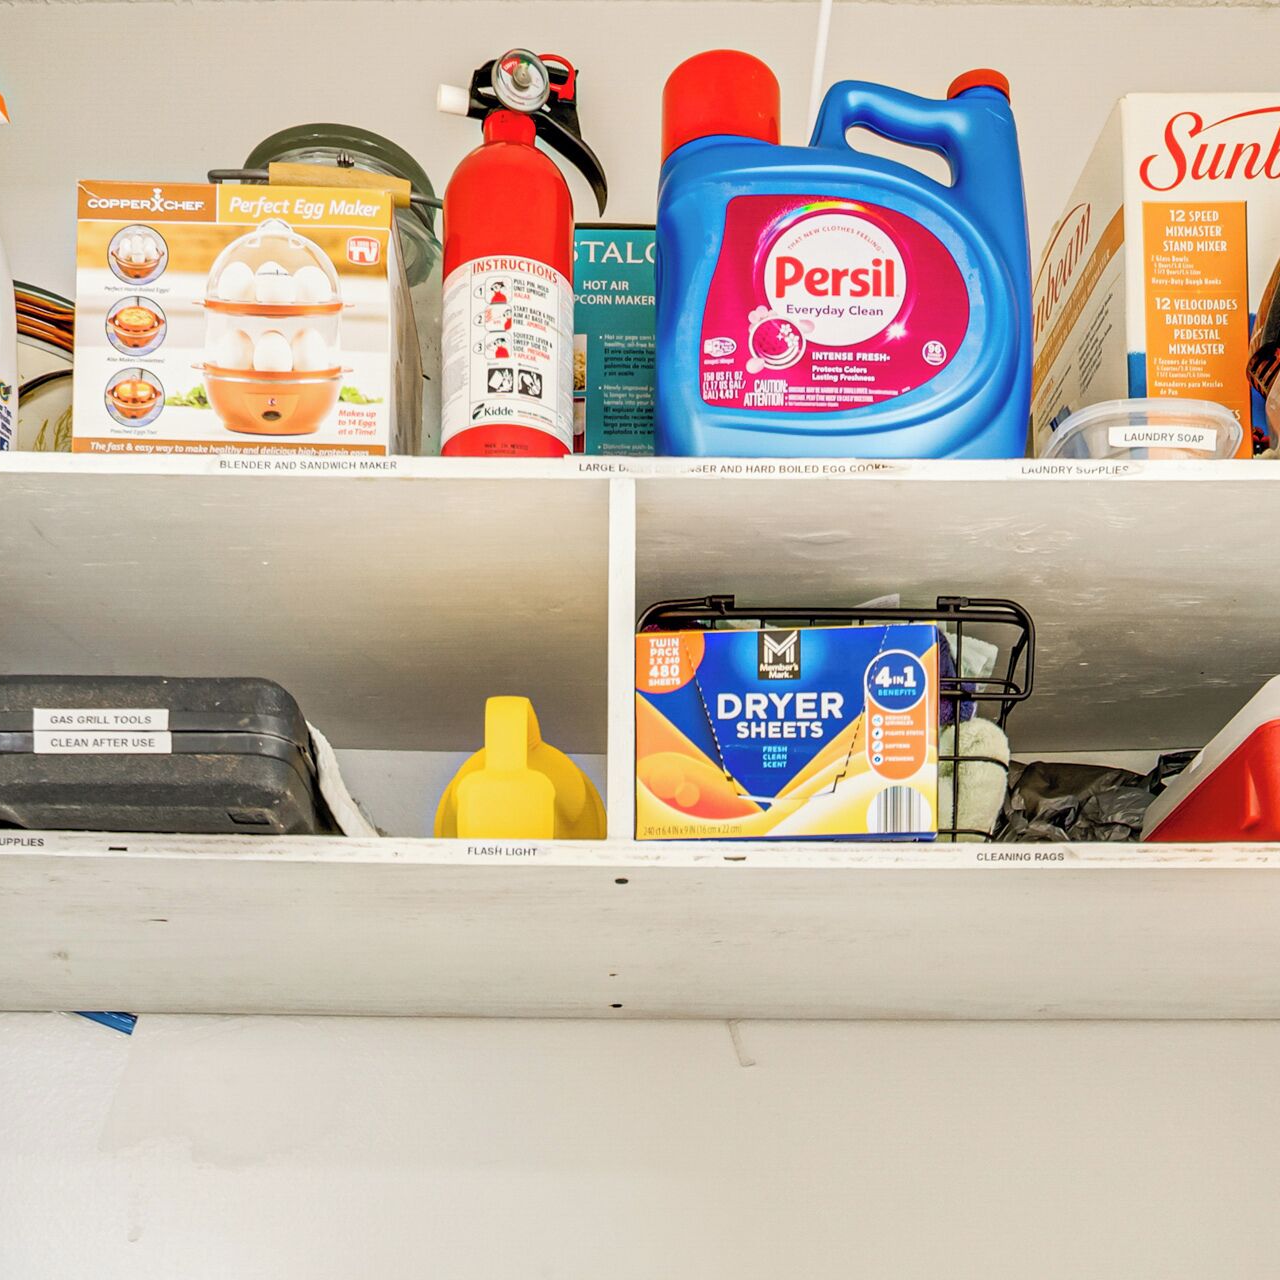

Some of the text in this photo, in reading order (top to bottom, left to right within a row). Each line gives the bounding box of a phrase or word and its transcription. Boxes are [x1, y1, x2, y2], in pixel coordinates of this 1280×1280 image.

[228, 196, 381, 220] Perfect Egg Maker
[1169, 209, 1219, 222] 12 SPEED
[1165, 225, 1222, 237] MIXMASTER
[787, 236, 802, 251] THAT
[803, 228, 820, 238] NEW
[822, 225, 855, 234] CLOTHES
[1163, 240, 1227, 252] STAND MIXER
[473, 259, 558, 284] INSTRUCTIONS
[775, 256, 895, 299] Persil
[583, 280, 629, 291] HOT AIR
[615, 294, 655, 305] MAKER
[1155, 297, 1238, 310] 12 VELOCIDADES
[786, 304, 884, 318] Everyday Clean
[1165, 314, 1229, 325] BATIDORA DE
[1173, 328, 1220, 340] PEDESTAL
[1168, 343, 1225, 355] MIXMASTER
[812, 352, 853, 362] INTENSE
[812, 365, 867, 374] Protects Colors
[812, 374, 875, 382] Lasting Freshness
[484, 405, 514, 417] Kidde
[1124, 433, 1204, 443] LAUNDRY SOAP
[90, 441, 106, 451] The
[106, 442, 125, 453] fast
[135, 444, 154, 453] easy
[156, 445, 173, 454] way
[185, 445, 208, 453] make
[209, 446, 241, 455] healthy
[243, 446, 259, 454] and
[261, 447, 297, 455] delicious
[219, 460, 398, 470] BLENDER AND SANDWICH MAKER
[579, 463, 615, 473] LARGE
[720, 464, 742, 474] AND
[745, 464, 775, 474] HARD
[779, 464, 819, 474] BOILED
[822, 464, 846, 474] EGG
[1021, 465, 1072, 475] LAUNDRY
[649, 638, 679, 657] TWIN PACK
[649, 665, 679, 678] 480
[760, 663, 799, 672] Member's
[648, 678, 681, 687] SHEETS
[717, 692, 844, 720] DRYER
[50, 715, 152, 724] GAS GRILL TOOLS
[736, 721, 823, 739] SHEETS
[50, 738, 156, 748] CLEAN AFTER USE
[763, 745, 787, 753] FRESH
[763, 753, 787, 761] CLEAN
[467, 845, 538, 856] FLASH LIGHT
[976, 852, 1065, 861] CLEANING RAGS
